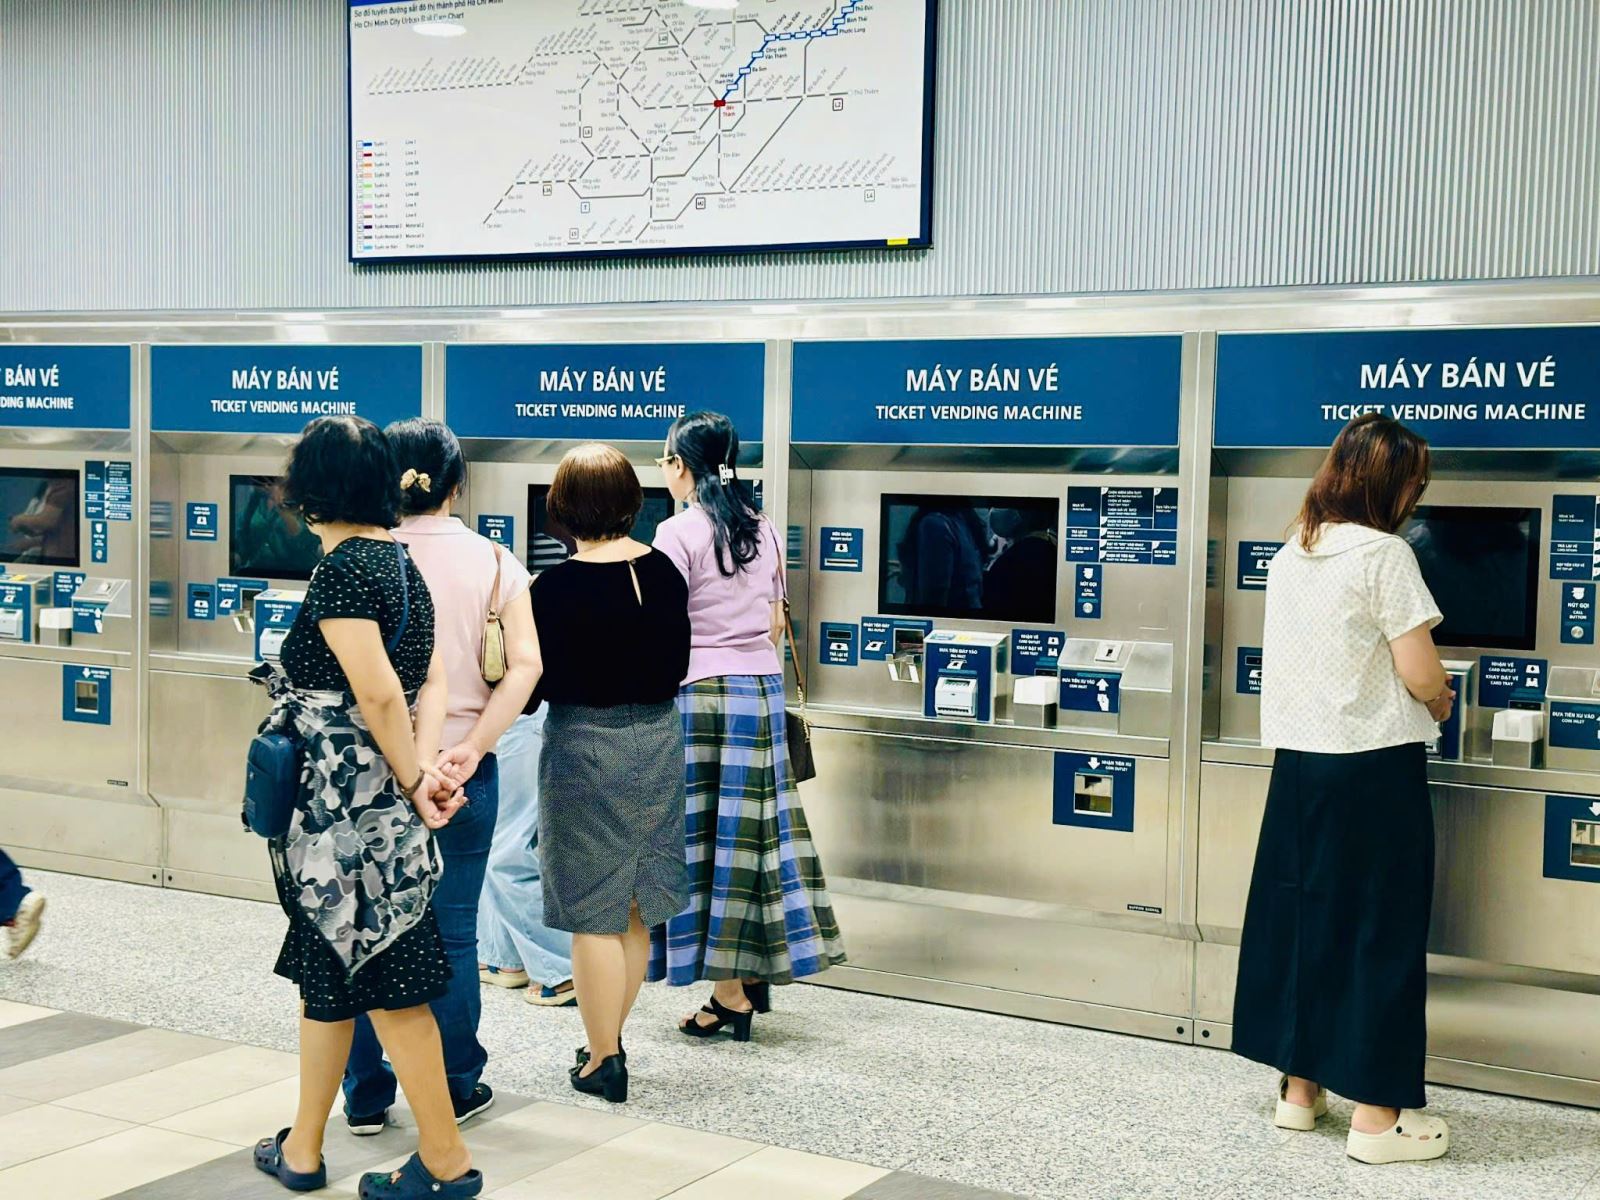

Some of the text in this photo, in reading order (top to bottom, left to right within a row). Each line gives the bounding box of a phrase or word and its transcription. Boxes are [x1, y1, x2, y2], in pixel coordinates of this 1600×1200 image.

[390, 18, 400, 27] City
[5, 364, 59, 387] BÁN VÉ
[232, 366, 339, 390] MÁY BÁN VÉ
[540, 366, 666, 392] MÁY BÁN VÉ
[906, 364, 1058, 391] MÁY BÁN VÉ
[1361, 356, 1556, 389] MÁY BÁN VÉ
[26, 396, 74, 410] MACHINE
[211, 400, 355, 415] TICKET VENDING MACHINE
[515, 404, 685, 418] TICKET VENDING MACHINE
[876, 405, 1082, 420] TICKET VENDING MACHINE
[1391, 404, 1477, 420] VENDING
[1485, 404, 1586, 420] MACHINE
